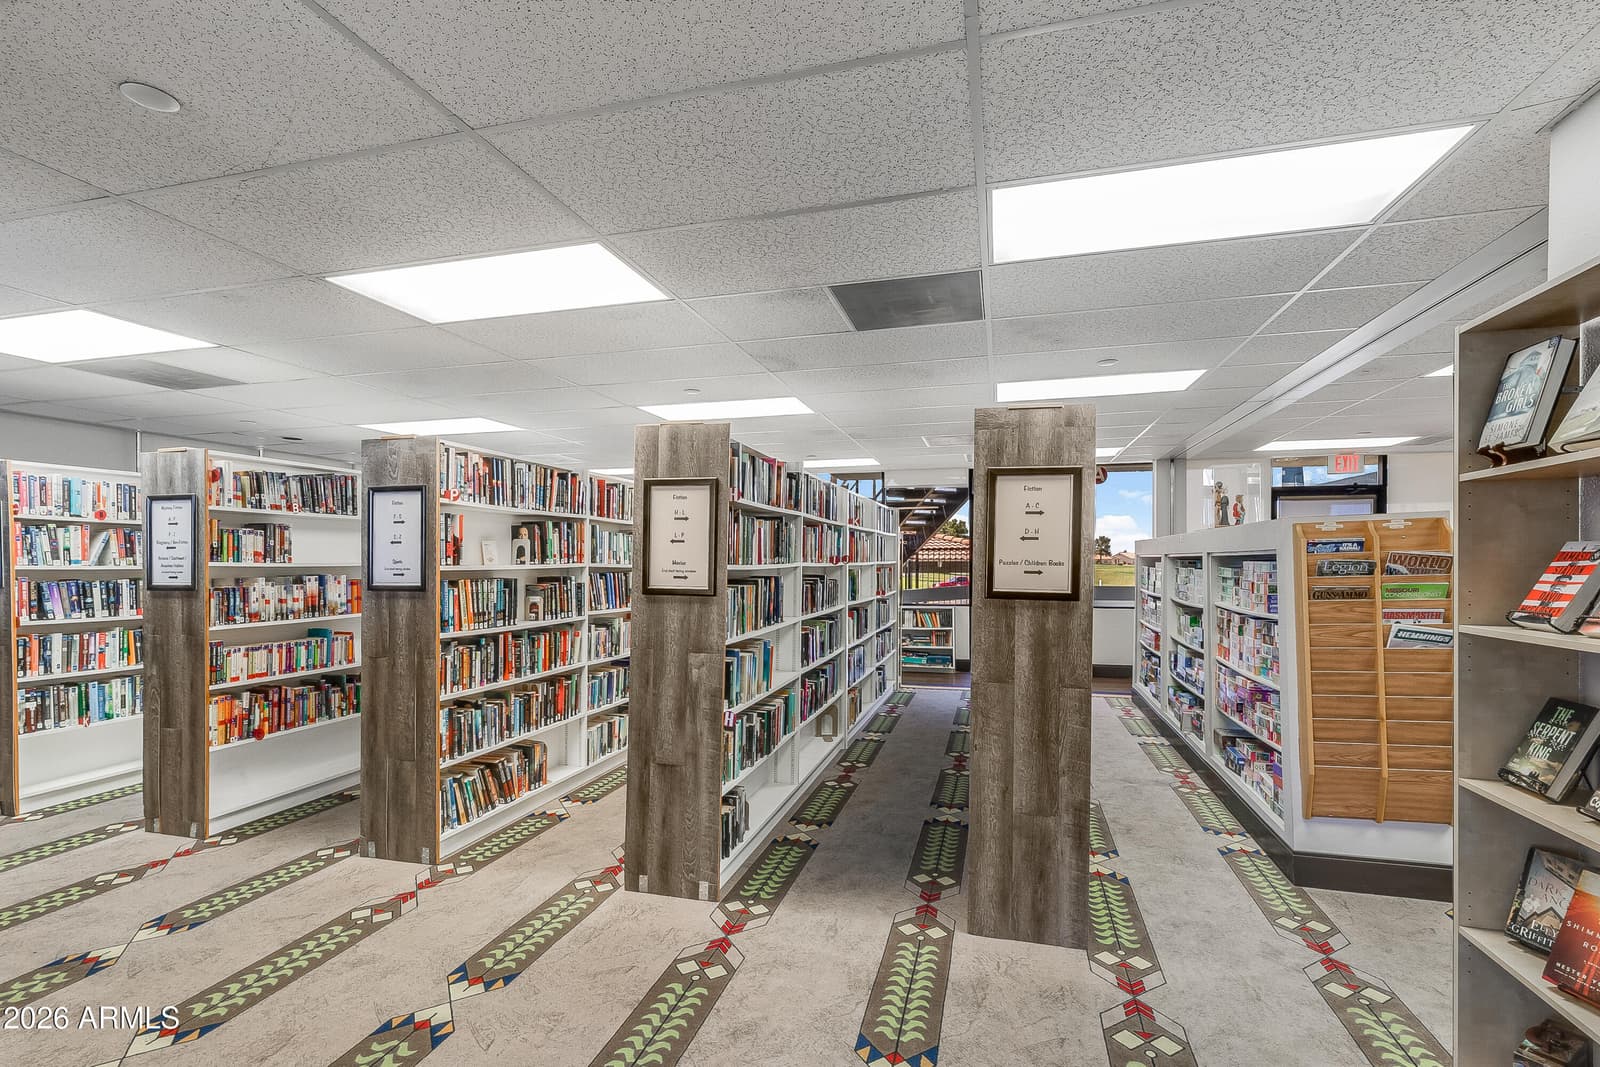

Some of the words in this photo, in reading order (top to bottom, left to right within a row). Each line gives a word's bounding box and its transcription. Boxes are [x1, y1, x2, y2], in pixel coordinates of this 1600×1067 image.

[1495, 381, 1535, 404] BROKEN
[1505, 394, 1537, 413] GIRLS
[1335, 454, 1359, 473] EXIT
[450, 489, 459, 501] P
[1048, 559, 1065, 567] Books
[1324, 561, 1368, 574] Legion
[1392, 554, 1452, 569] WORLD
[1397, 630, 1451, 642] HEMMINGS
[725, 711, 734, 727] H
[1551, 706, 1575, 724] THE
[1532, 721, 1577, 746] SERPENT
[1526, 742, 1553, 760] KING
[1511, 923, 1556, 947] GRIFFIT
[1582, 941, 1600, 954] RO
